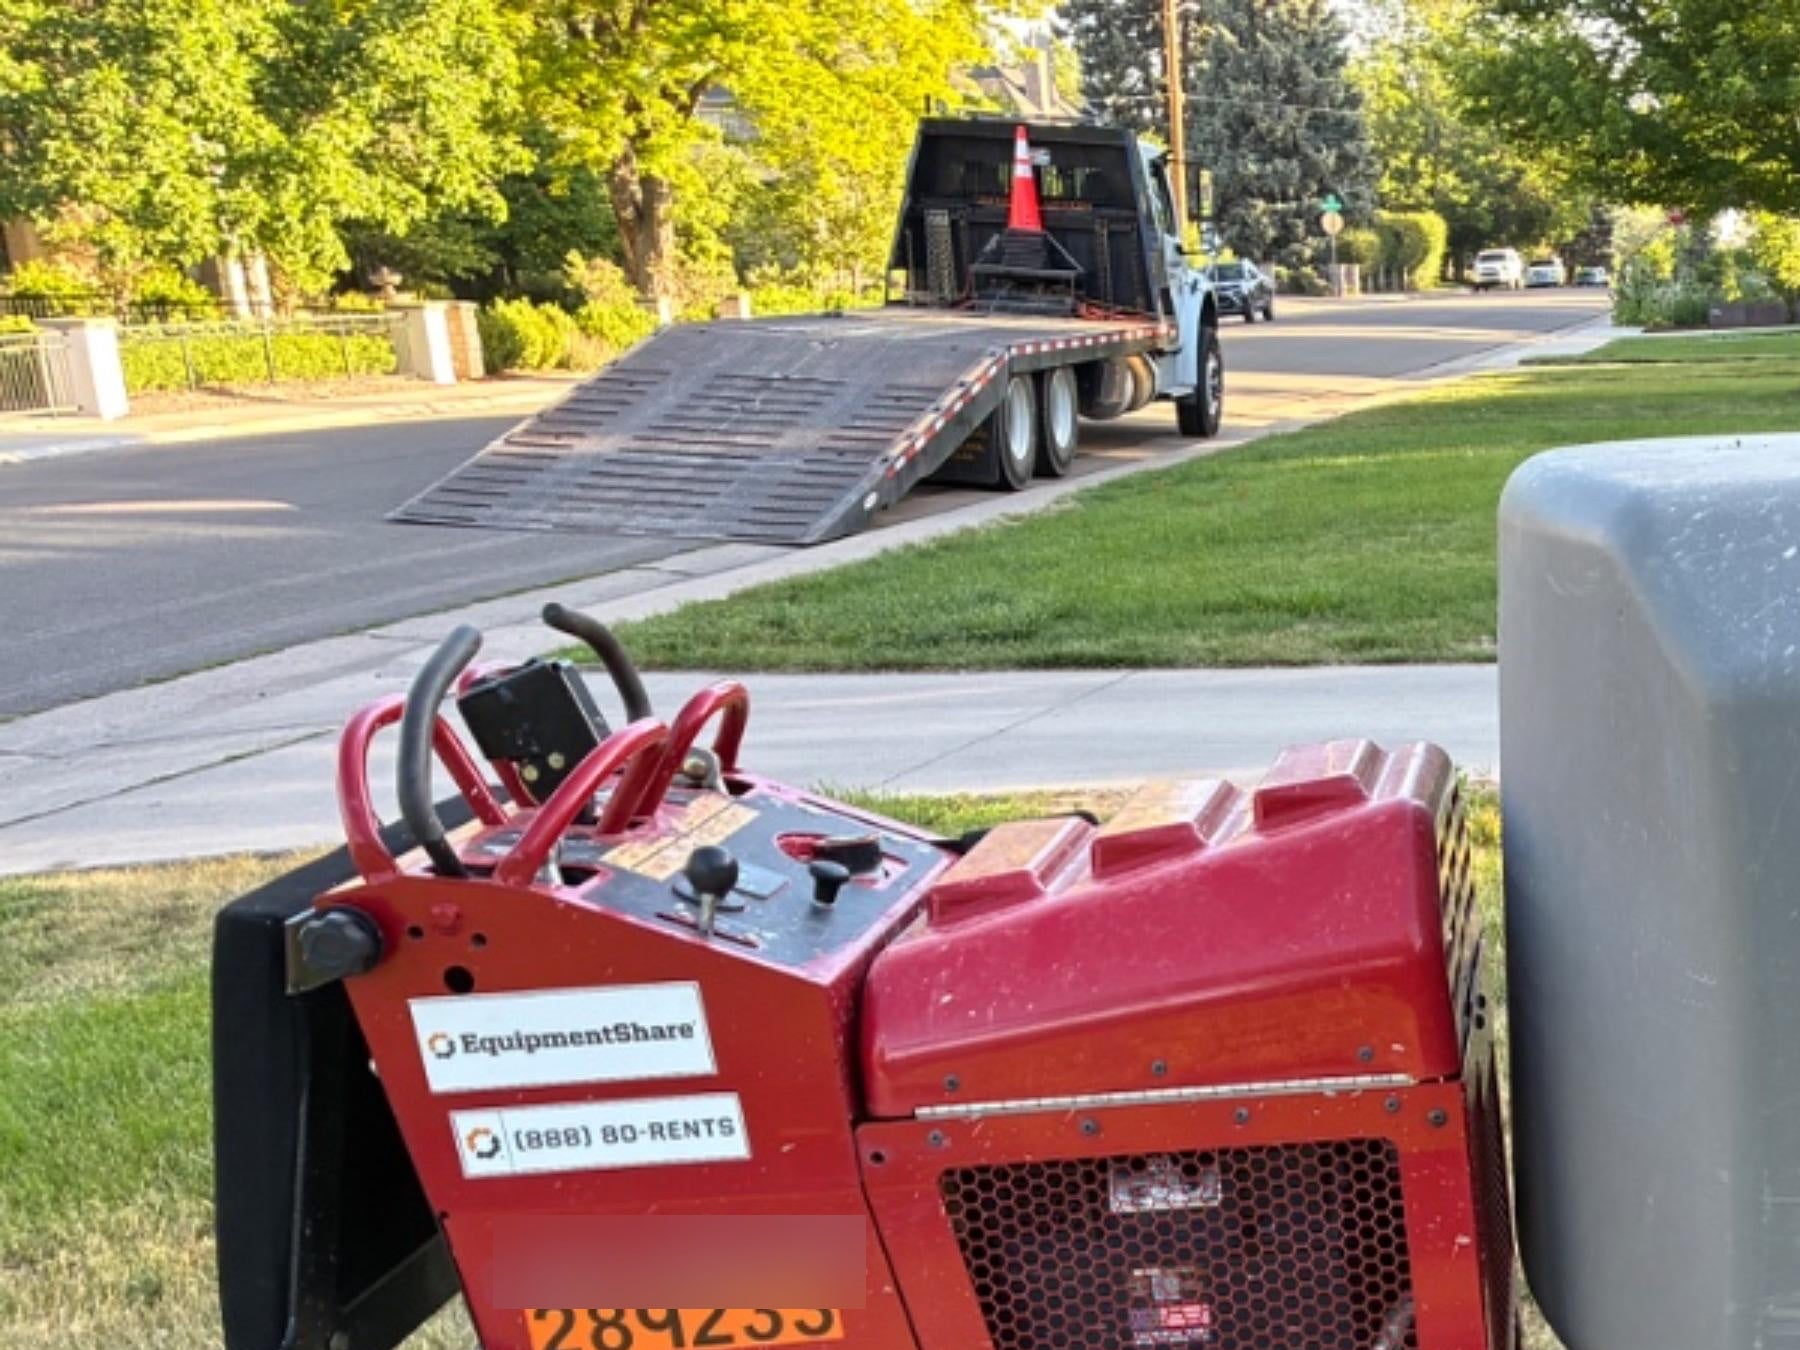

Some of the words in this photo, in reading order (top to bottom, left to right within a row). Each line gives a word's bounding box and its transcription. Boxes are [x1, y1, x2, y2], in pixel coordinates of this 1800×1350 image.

[459, 1022, 694, 1056] EquipmentShare
[513, 1125, 593, 1152] (888)
[601, 1116, 736, 1145] 80-RENTS
